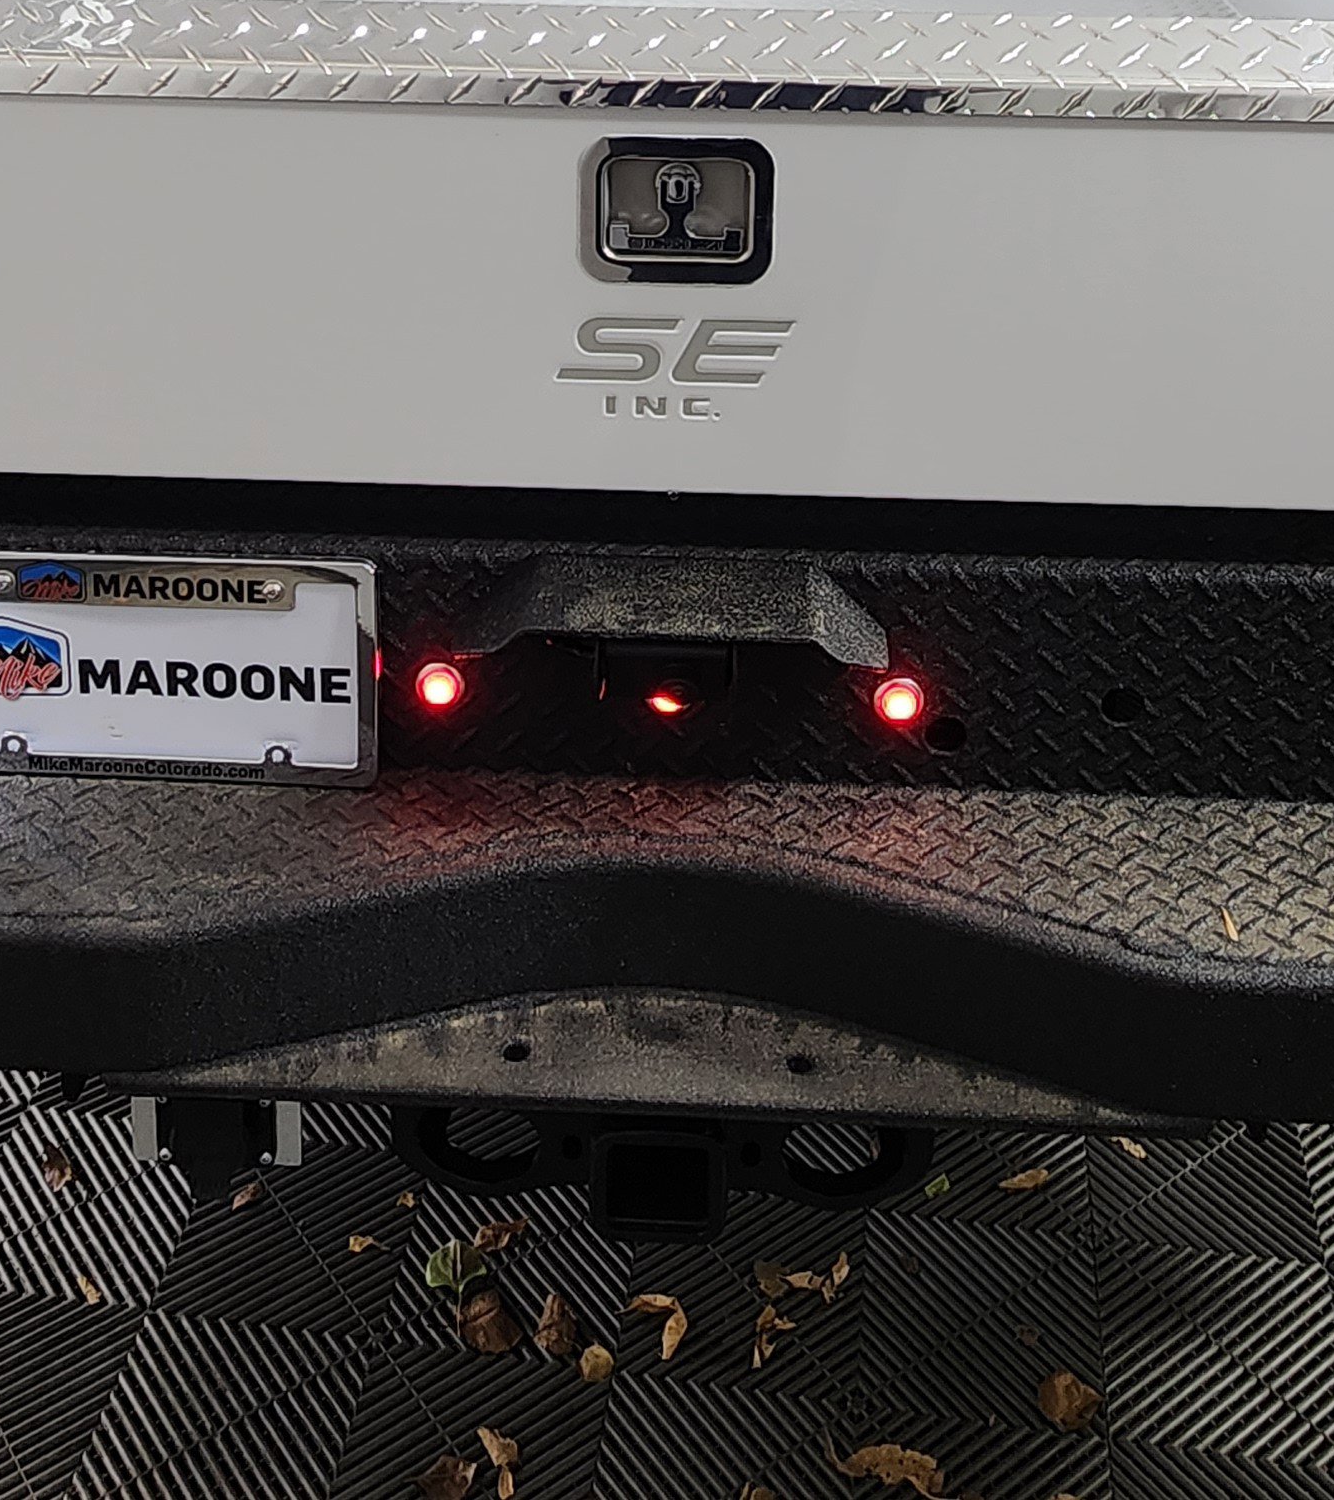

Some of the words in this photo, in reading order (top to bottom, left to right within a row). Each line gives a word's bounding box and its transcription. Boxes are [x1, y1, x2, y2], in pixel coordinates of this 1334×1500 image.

[555, 316, 797, 385] SE
[604, 395, 721, 420] INC.
[93, 573, 267, 604] MAROONE
[77, 658, 352, 704] MAROONE
[28, 757, 266, 780] MikeMarooneColorado.com
